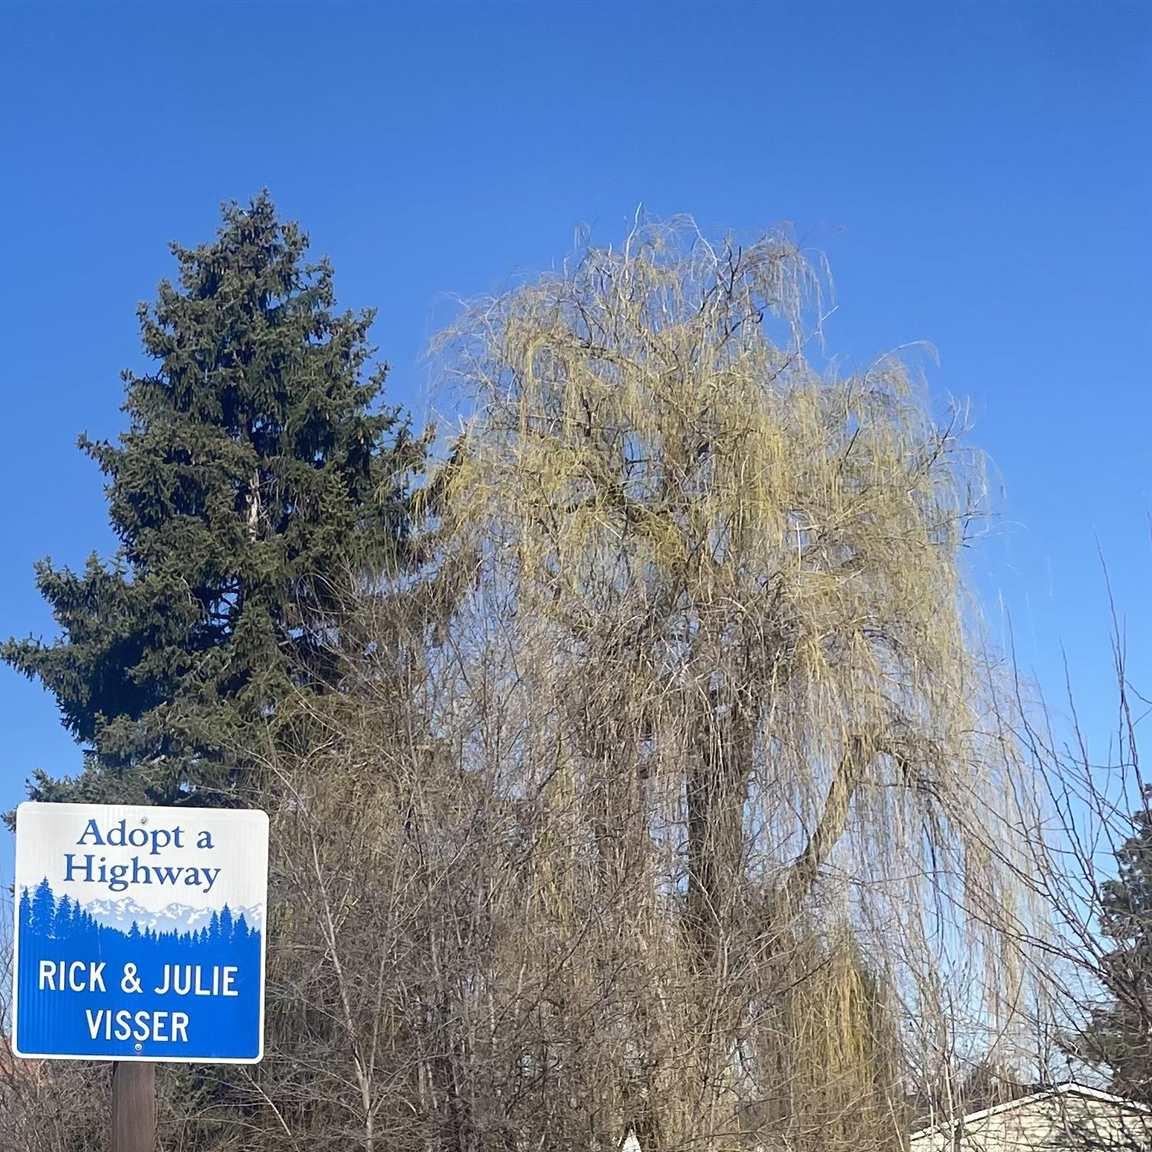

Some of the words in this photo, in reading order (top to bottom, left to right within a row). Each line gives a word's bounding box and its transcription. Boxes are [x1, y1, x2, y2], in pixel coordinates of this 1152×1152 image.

[76, 818, 185, 855] Adopt
[196, 830, 215, 850] a
[63, 853, 222, 894] Highway
[38, 959, 107, 993] RICK
[120, 962, 144, 994] &
[154, 964, 239, 997] JULIE
[85, 1009, 190, 1042] VISSER
